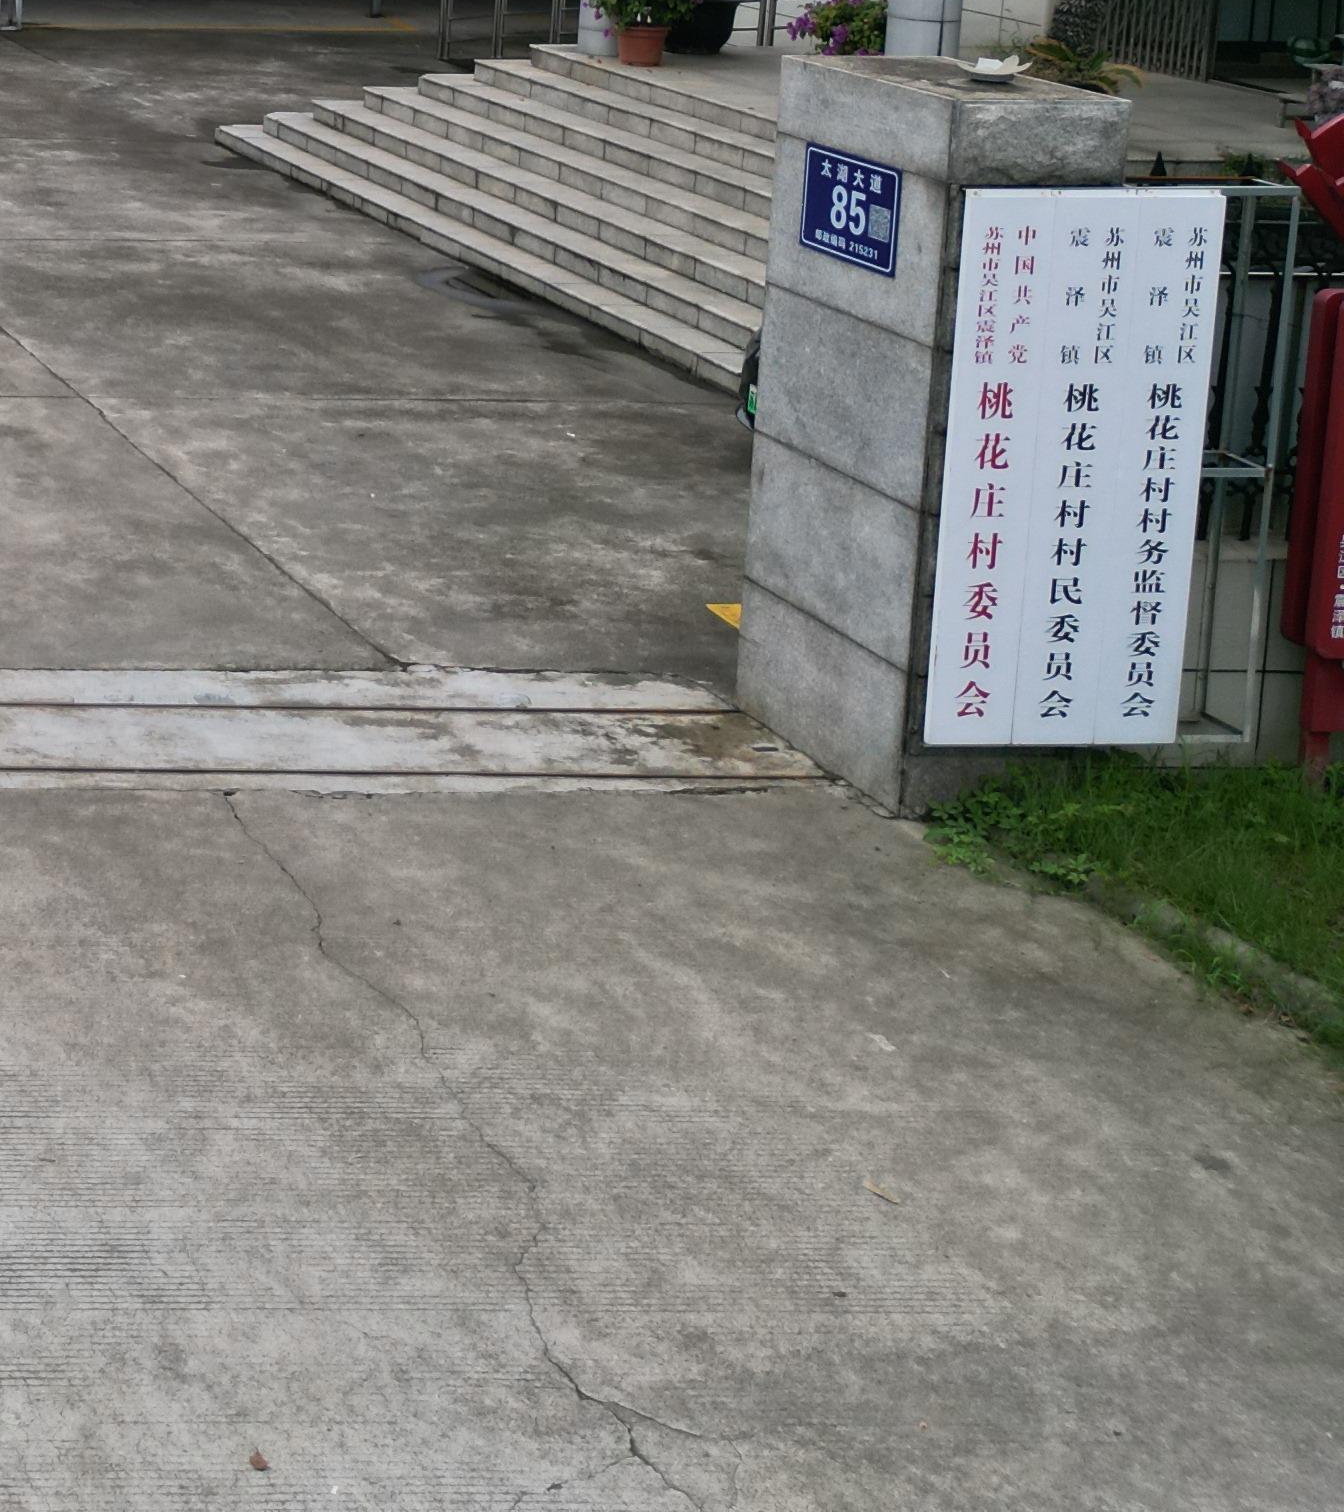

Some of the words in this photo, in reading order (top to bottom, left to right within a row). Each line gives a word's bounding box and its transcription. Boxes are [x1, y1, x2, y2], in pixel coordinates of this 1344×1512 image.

[815, 229, 846, 250] 邮政编码
[849, 242, 878, 259] 215231
[821, 159, 882, 194] 太湖大道
[830, 185, 866, 235] 85
[974, 225, 1005, 365] 苏州市吴江区震泽镇
[1008, 225, 1037, 365] 中国共产党
[1060, 227, 1092, 365] 震泽镇
[1093, 226, 1125, 365] 苏州市吴江区
[1143, 227, 1175, 365] 震泽镇
[1176, 226, 1209, 365] 苏州市吴江区
[953, 380, 1013, 718] 桃花庄村委员会
[1038, 382, 1099, 718] 桃花庄村村民委员会
[1119, 382, 1182, 718] 桃花庄村村务监督委员会
